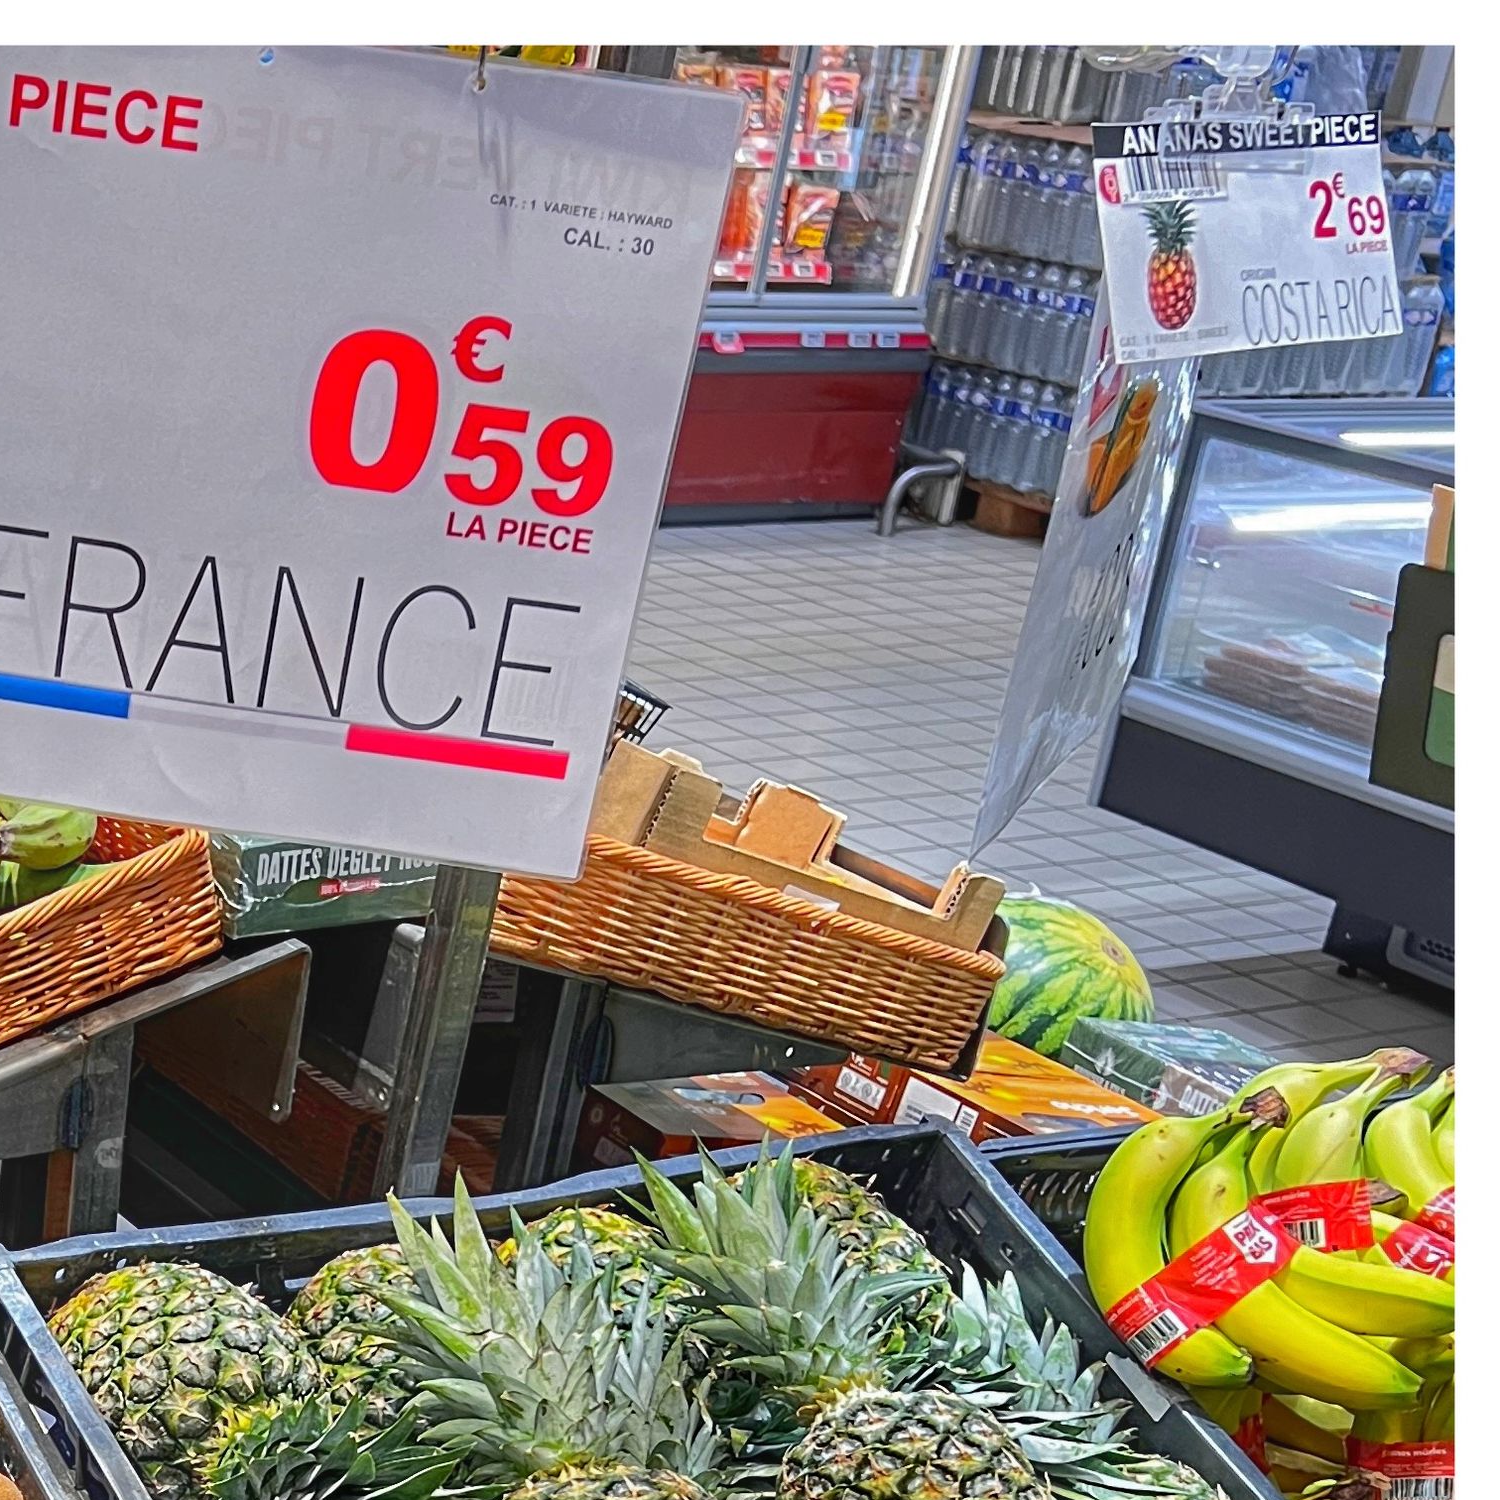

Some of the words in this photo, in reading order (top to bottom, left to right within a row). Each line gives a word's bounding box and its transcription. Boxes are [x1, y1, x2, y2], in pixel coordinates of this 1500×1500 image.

[8, 73, 204, 153] PIECE
[1122, 122, 1223, 156] ANANAS
[1310, 113, 1376, 145] PIECE
[544, 201, 597, 220] VARIETE
[607, 210, 673, 229] HAYWARD
[1309, 180, 1337, 238] 2
[1347, 195, 1385, 236] 69
[630, 236, 655, 256] 30
[1242, 279, 1333, 346] COSTA
[1335, 276, 1400, 337] RICA
[309, 328, 440, 494] 0
[444, 403, 614, 518] 59
[445, 511, 486, 541] LA
[497, 518, 594, 555] PIECE
[257, 848, 322, 886] DATTES
